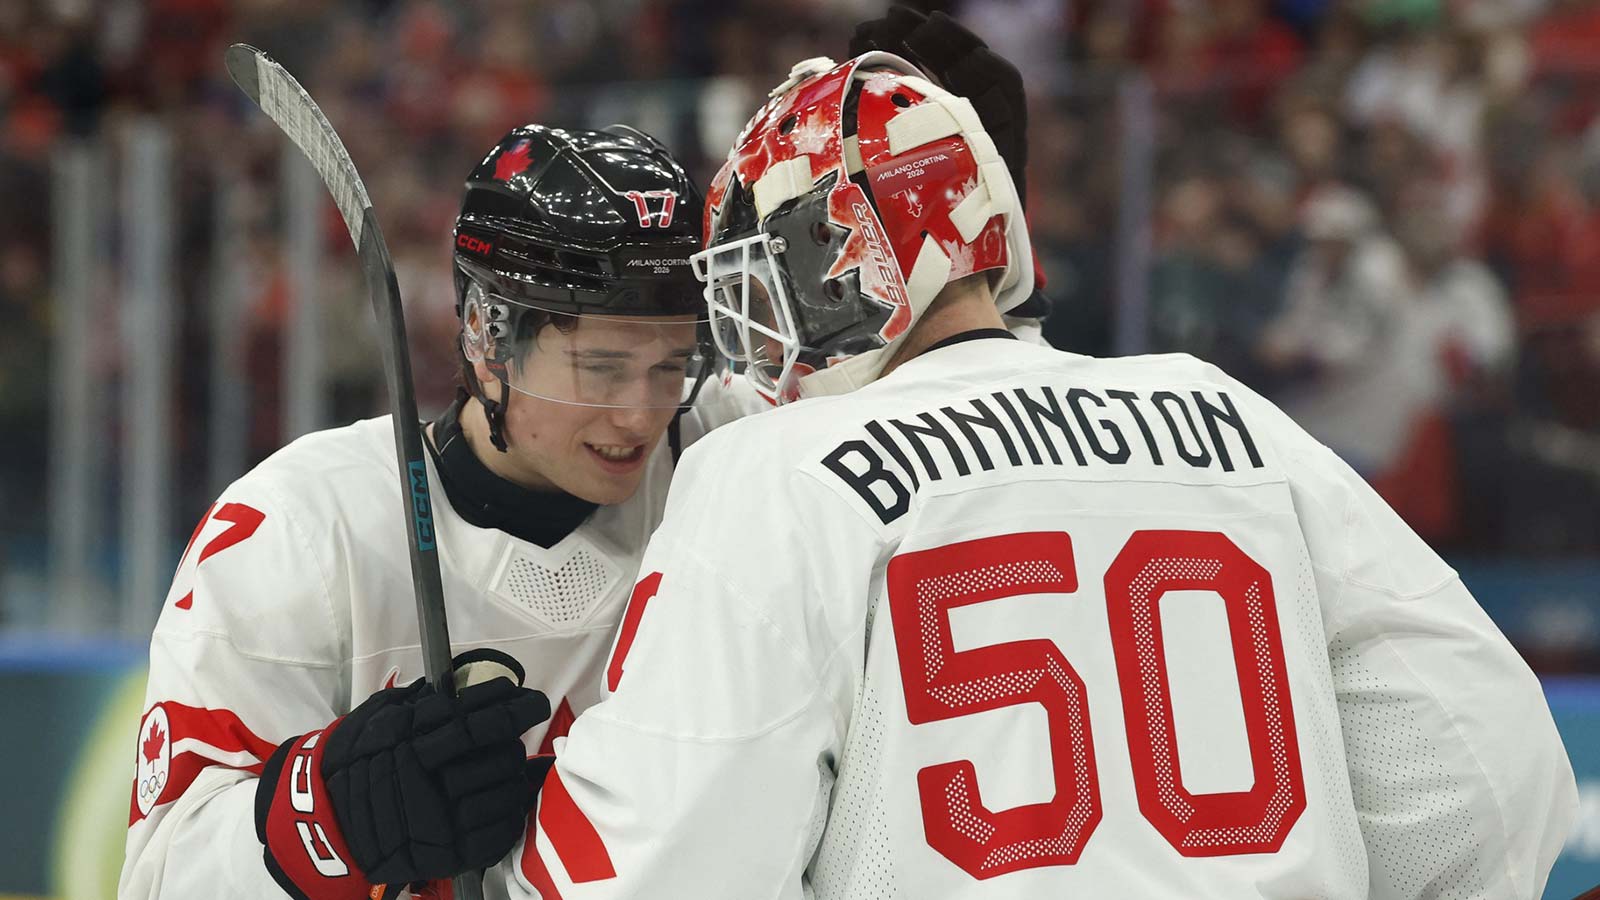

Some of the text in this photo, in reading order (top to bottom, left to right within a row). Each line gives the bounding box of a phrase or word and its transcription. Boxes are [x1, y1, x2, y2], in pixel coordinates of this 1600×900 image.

[877, 154, 949, 182] MILANO CORTINA
[906, 168, 925, 179] 2026
[624, 190, 677, 228] 17
[457, 233, 492, 256] CCM
[852, 203, 906, 306] BAUER
[653, 266, 670, 274] 2026
[820, 386, 1265, 526] BINNINGTON
[411, 467, 433, 543] CCM
[887, 529, 1308, 881] 50
